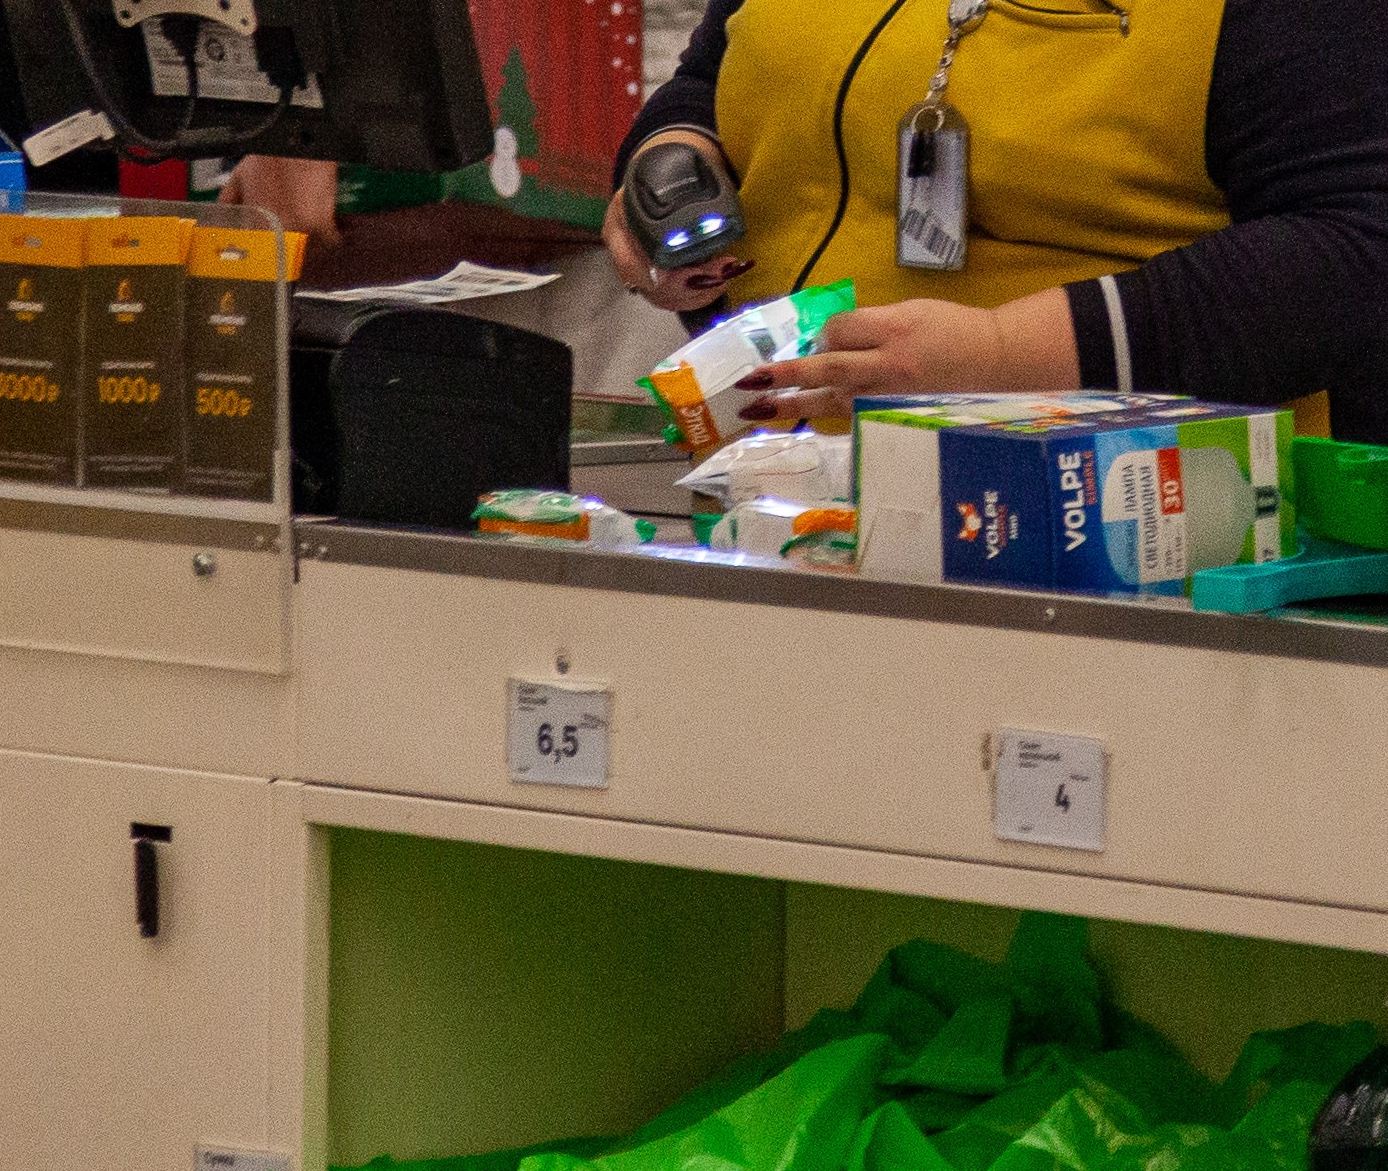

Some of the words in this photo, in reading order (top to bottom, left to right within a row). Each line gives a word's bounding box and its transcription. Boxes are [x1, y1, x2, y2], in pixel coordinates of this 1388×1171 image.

[1058, 451, 1086, 553] VOLPE
[1122, 463, 1138, 513] ЛАМПА
[1161, 480, 1182, 510] 30
[983, 490, 1001, 561] VOLPE
[537, 723, 579, 765] 6,5
[1054, 783, 1071, 814] 4
